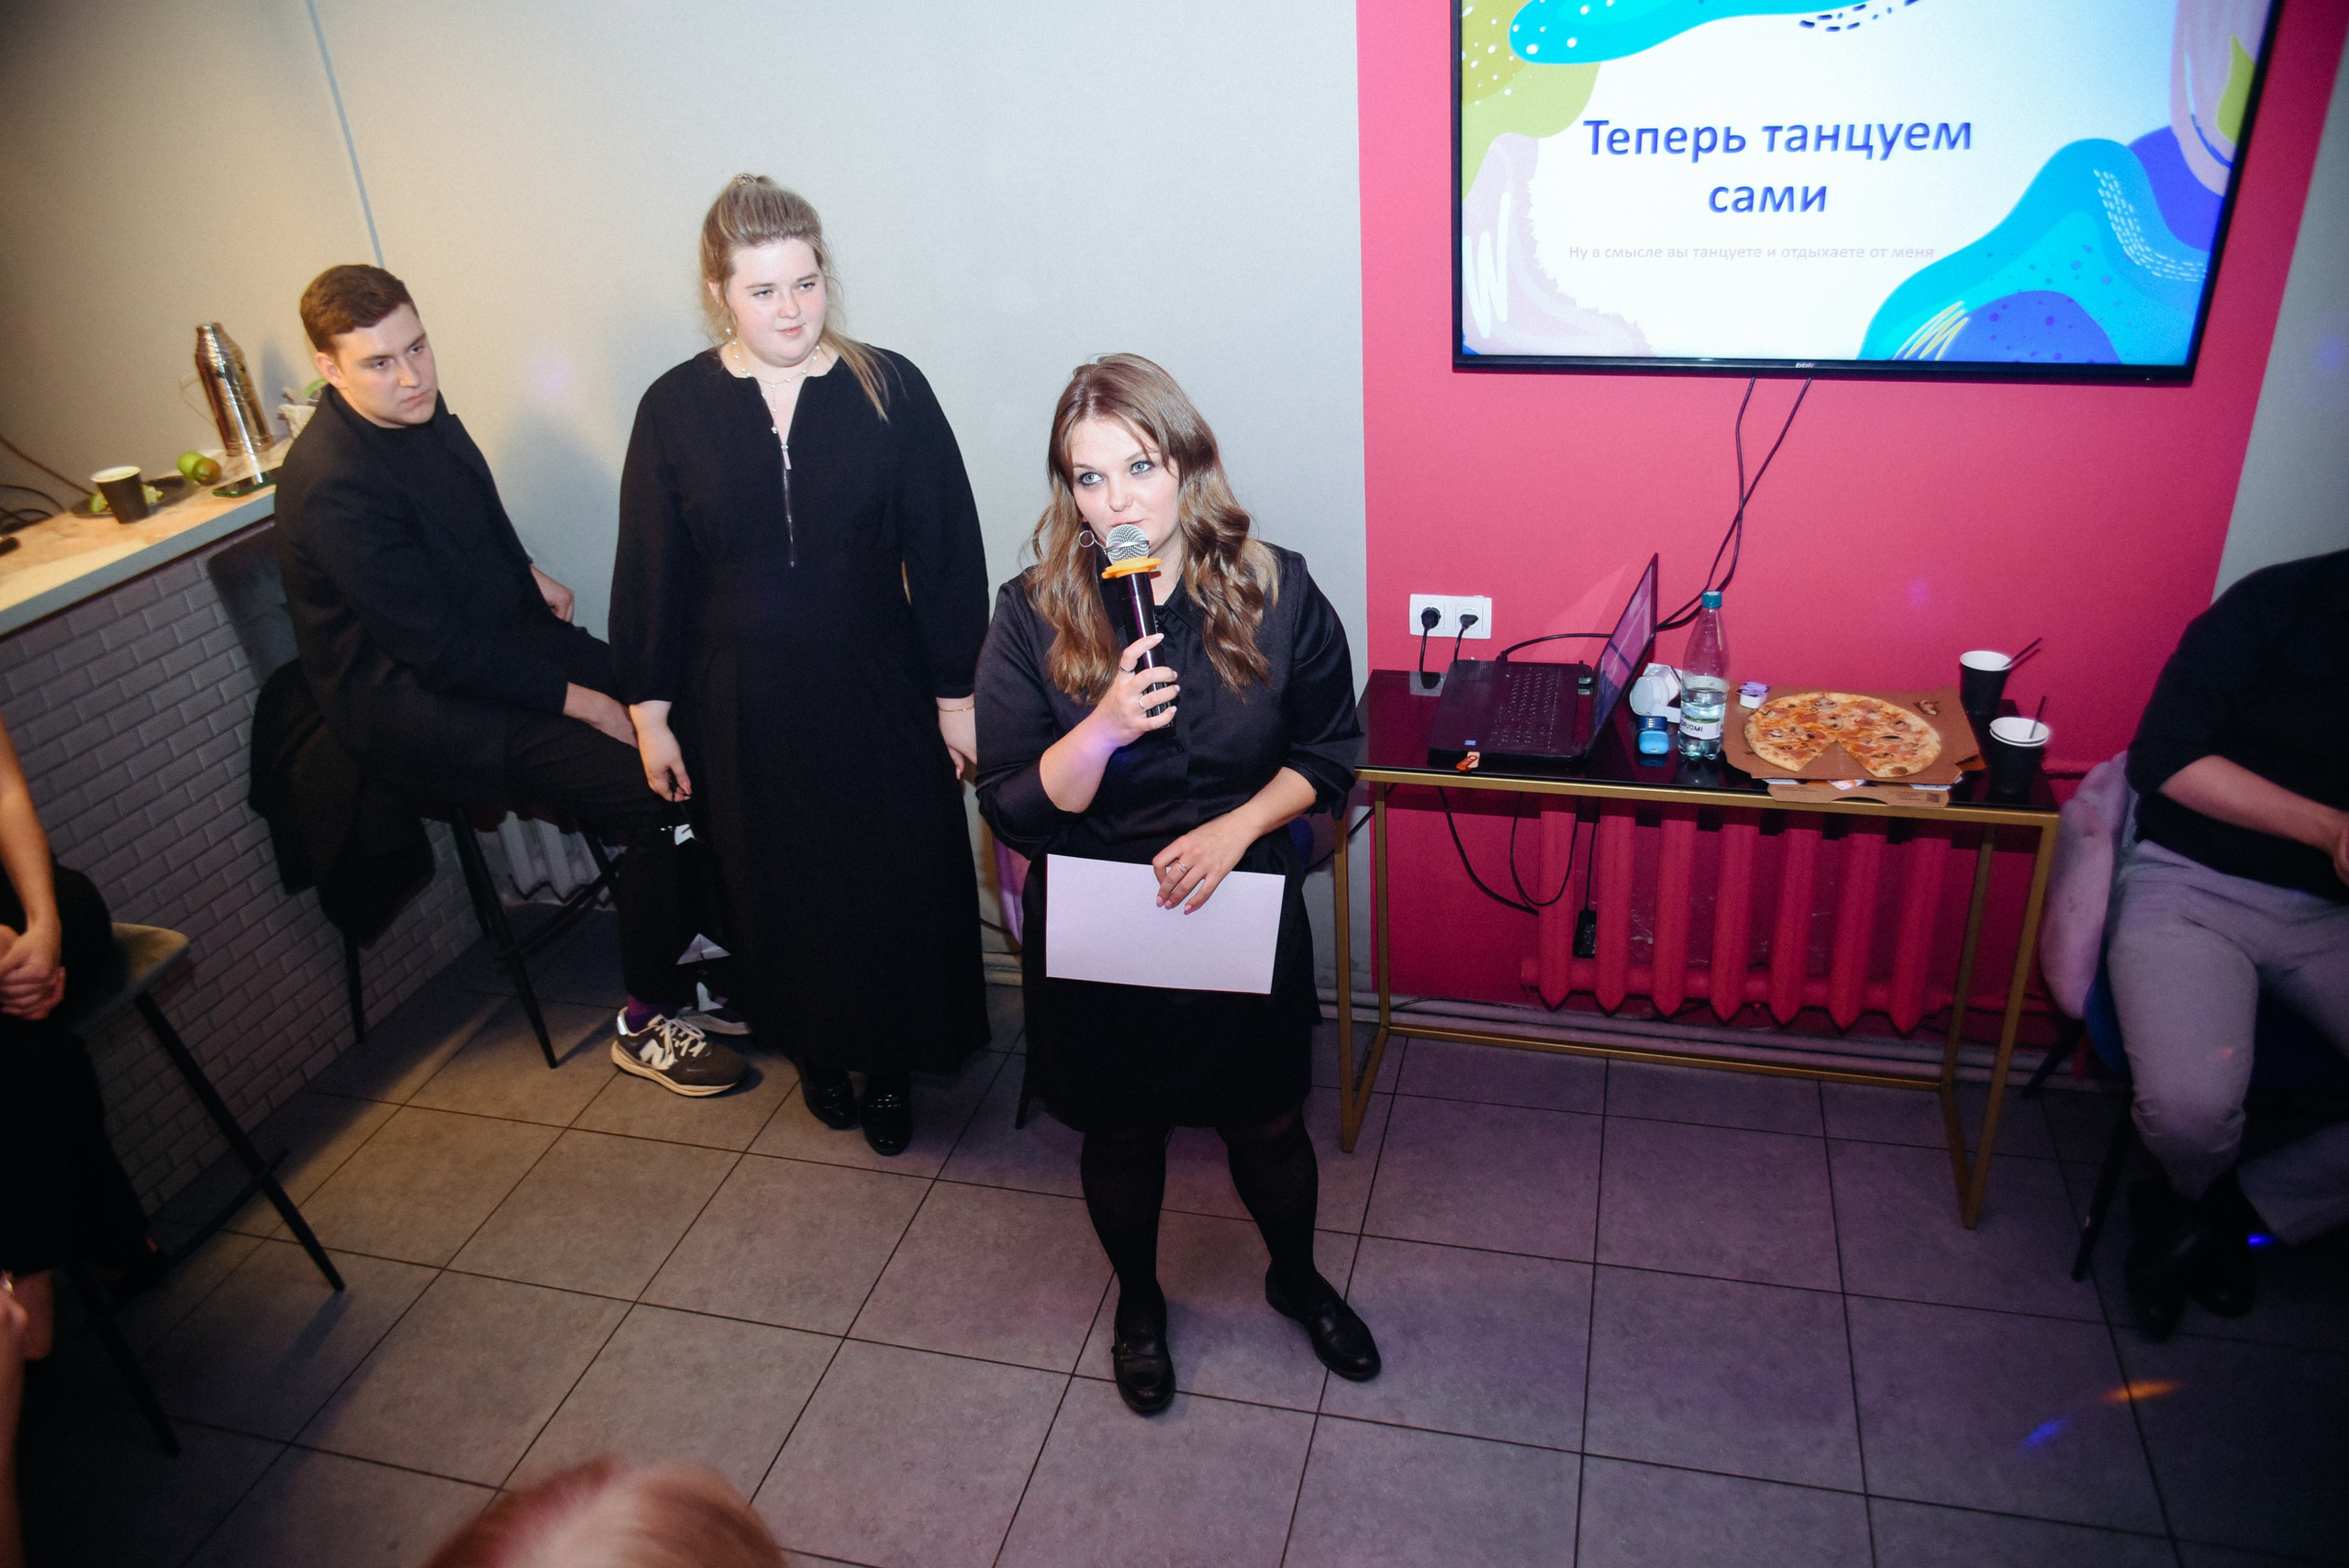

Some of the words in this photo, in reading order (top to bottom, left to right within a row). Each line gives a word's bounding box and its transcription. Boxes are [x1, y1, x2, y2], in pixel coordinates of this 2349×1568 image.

[1583, 119, 1747, 163] Теперь
[1761, 122, 1972, 161] танцуем
[1708, 185, 1828, 214] сами
[1569, 246, 1588, 261] Ну
[1592, 249, 1600, 258] в
[1605, 248, 1663, 259] смысле
[1667, 248, 1688, 258] вы
[1692, 248, 1762, 261] танцуете
[1766, 248, 1776, 258] и
[1781, 248, 1865, 261] отдыхаете
[1869, 248, 1887, 258] от
[1891, 248, 1935, 259] меня
